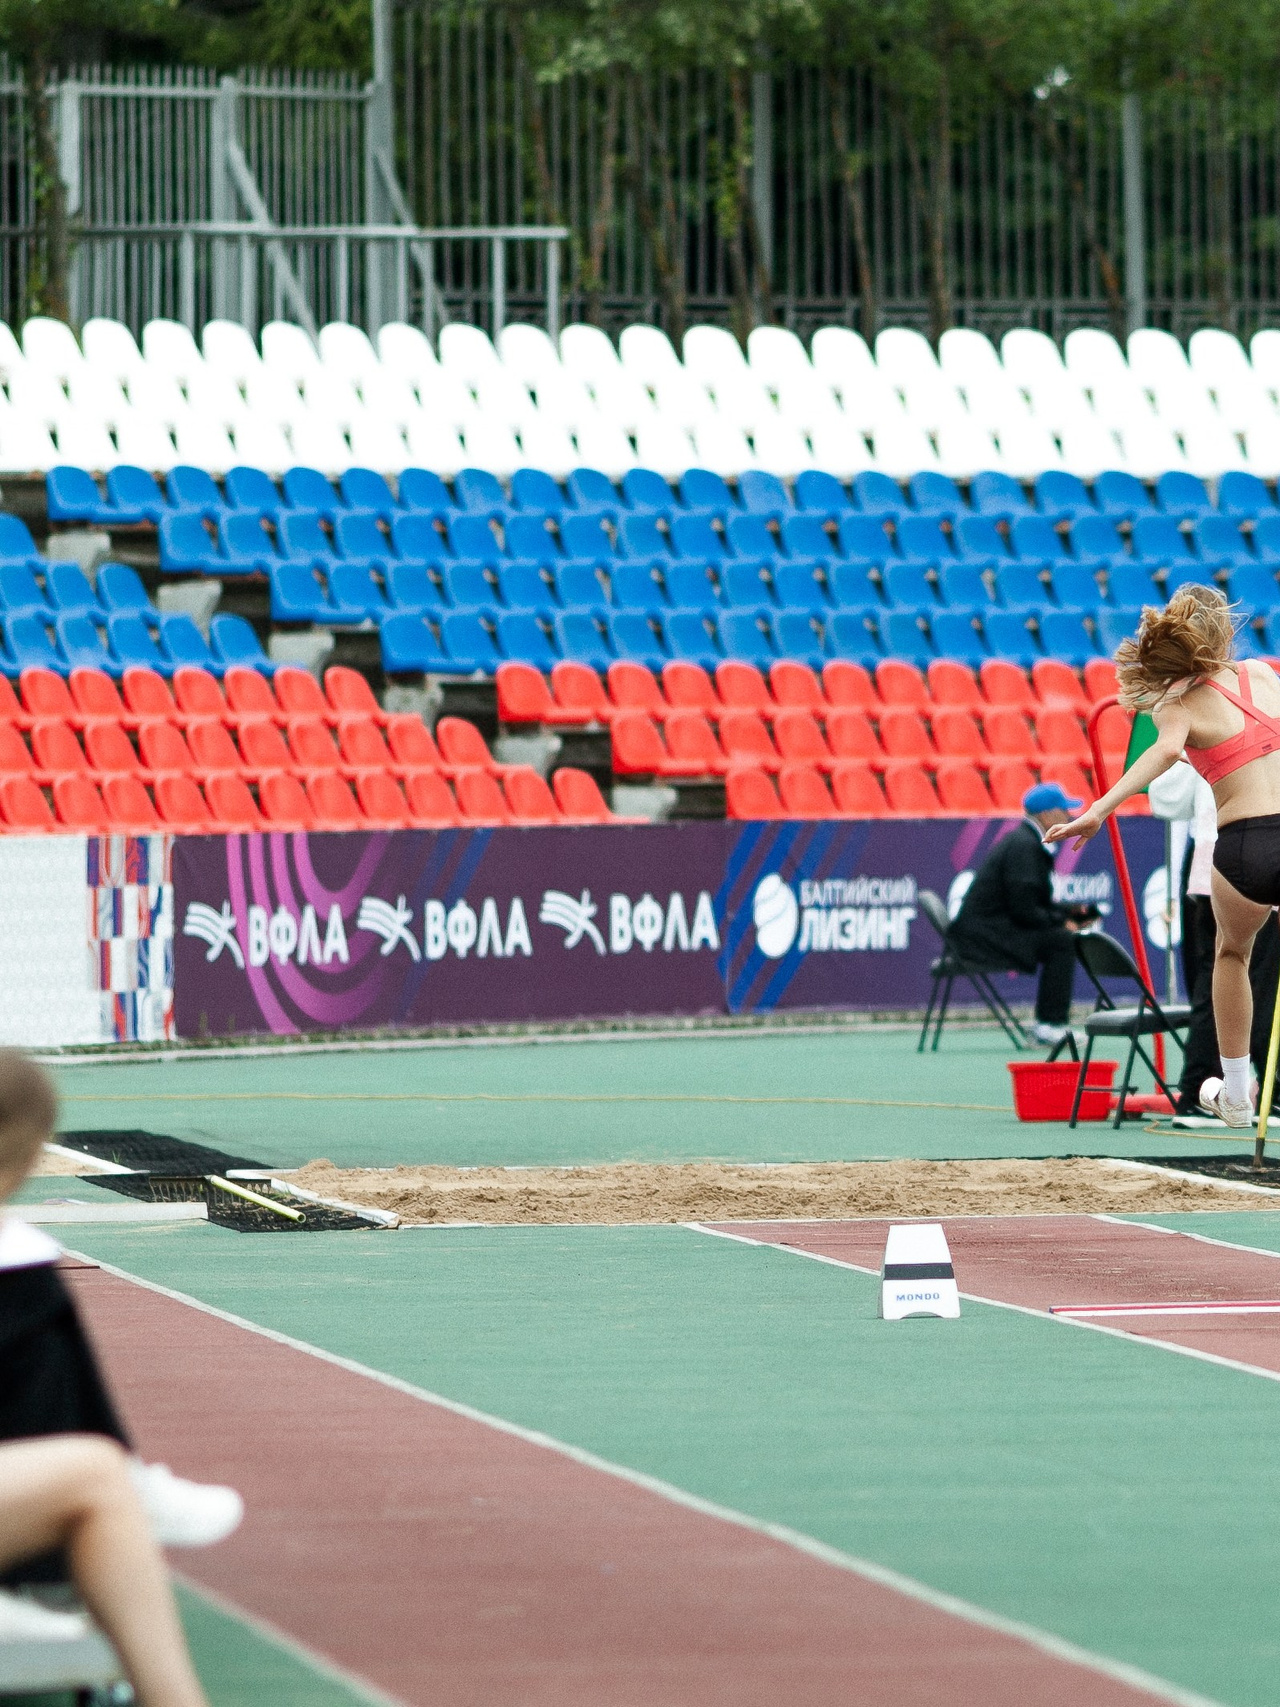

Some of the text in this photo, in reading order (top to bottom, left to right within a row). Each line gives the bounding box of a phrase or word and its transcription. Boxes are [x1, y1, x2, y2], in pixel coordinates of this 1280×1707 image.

[800, 874, 918, 906] БАЛТИЙСКИЙ
[248, 903, 350, 967] ВФЛА
[424, 895, 533, 960] ВФЛА
[609, 890, 721, 954] ВФЛА
[798, 907, 918, 952] ЛИЗИНГ
[896, 1292, 941, 1302] MONDO
